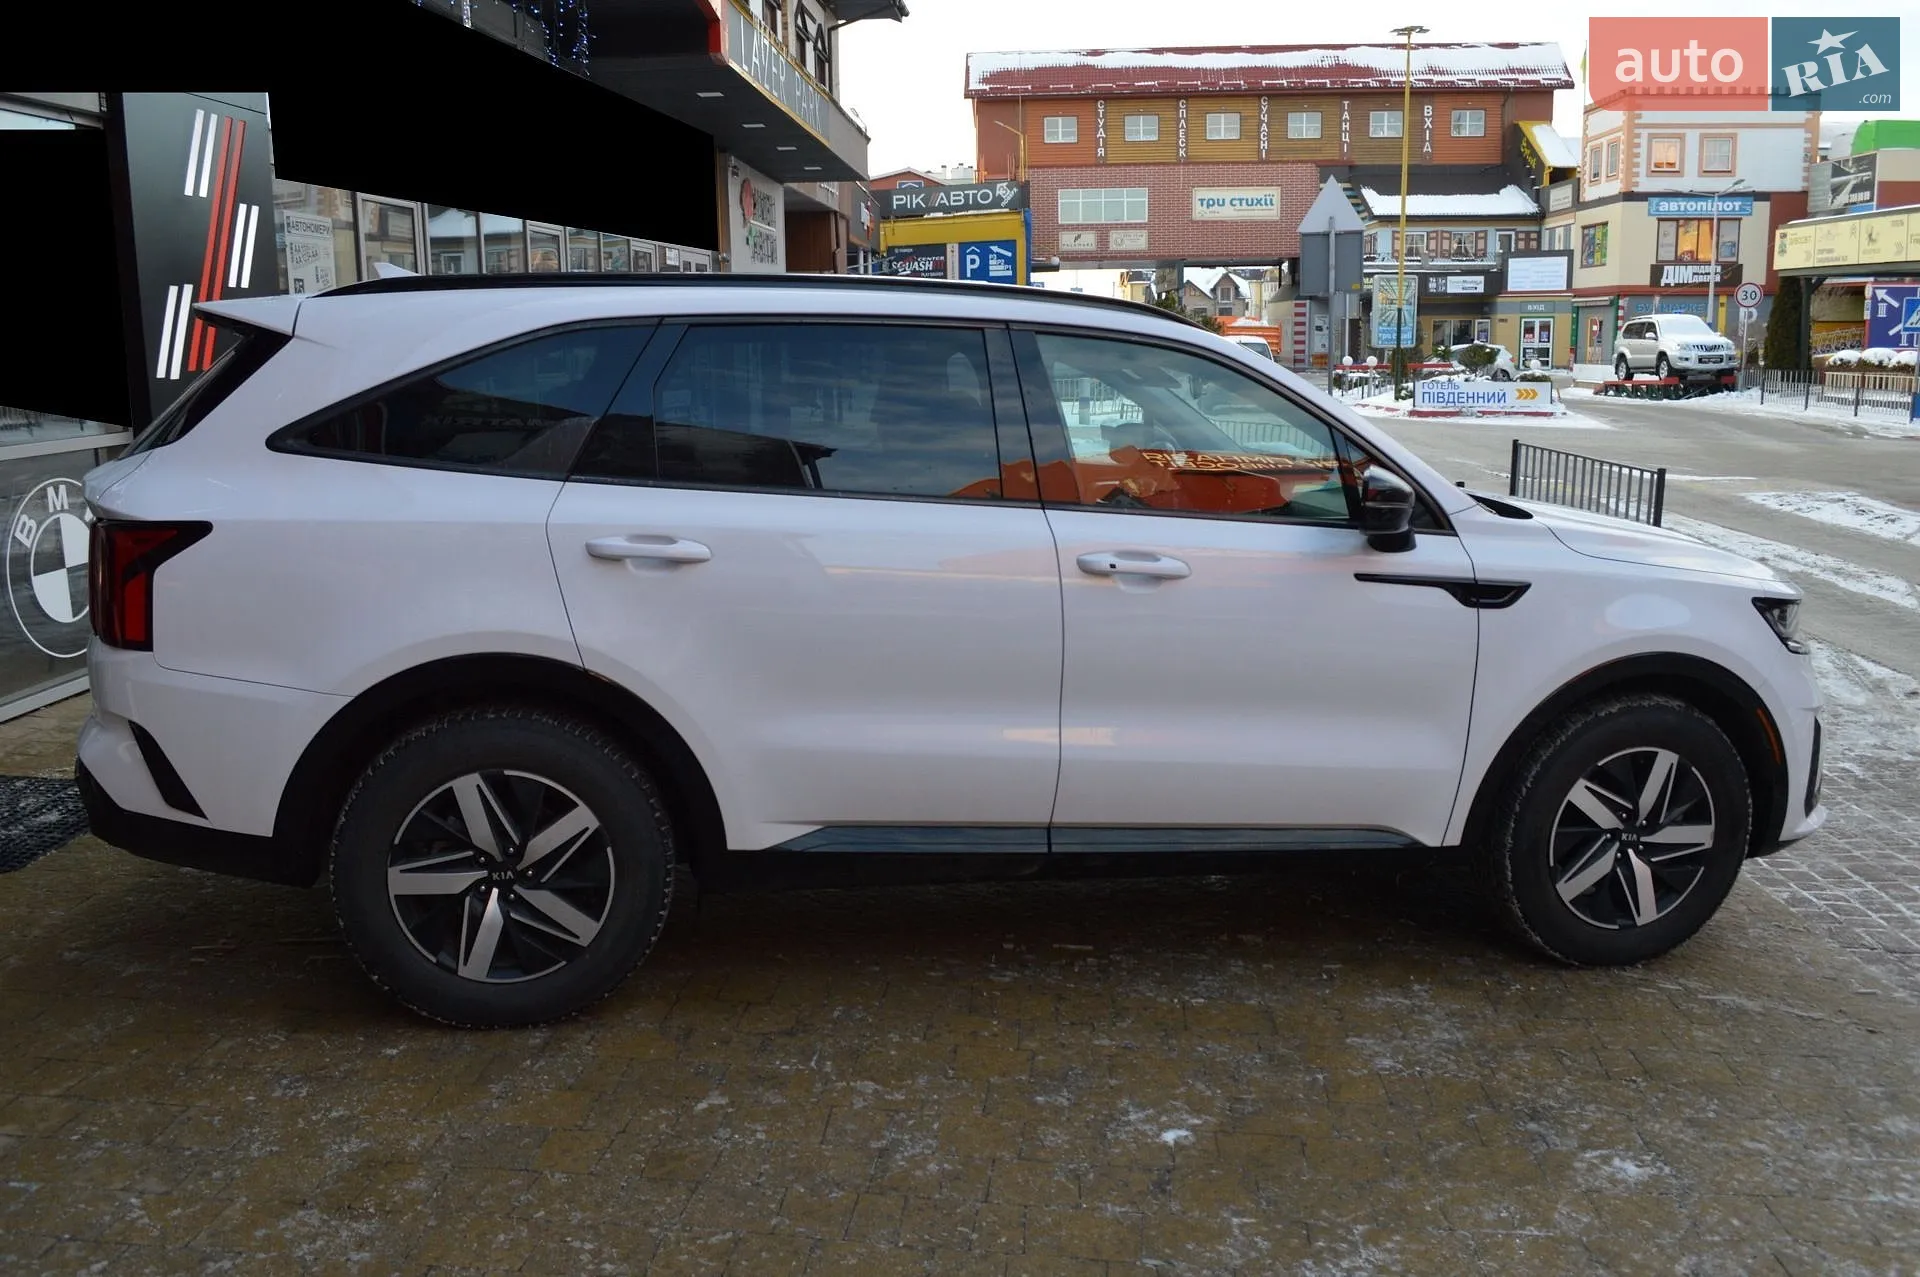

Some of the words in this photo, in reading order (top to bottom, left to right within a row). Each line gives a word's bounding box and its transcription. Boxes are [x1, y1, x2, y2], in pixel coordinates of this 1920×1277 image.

[741, 14, 787, 106] LAZER
[795, 70, 822, 135] PARK
[1096, 100, 1106, 157] СТУДІЯ
[1179, 99, 1187, 157] СПЛЕСК
[1260, 96, 1268, 160] СУЧАСНІ
[1342, 100, 1350, 153] ТАНЦІ
[1198, 197, 1225, 209] три
[1658, 200, 1742, 212] автопілот
[966, 254, 980, 278] P
[1660, 265, 1692, 287] ДІМ
[1741, 290, 1757, 299] 30
[1422, 381, 1460, 390] ГОТЕЛЬ
[1421, 388, 1507, 406] ПІВДЕННИЙ
[14, 484, 96, 549] BM
[1621, 832, 1638, 841] KIA
[491, 870, 515, 880] KIA
